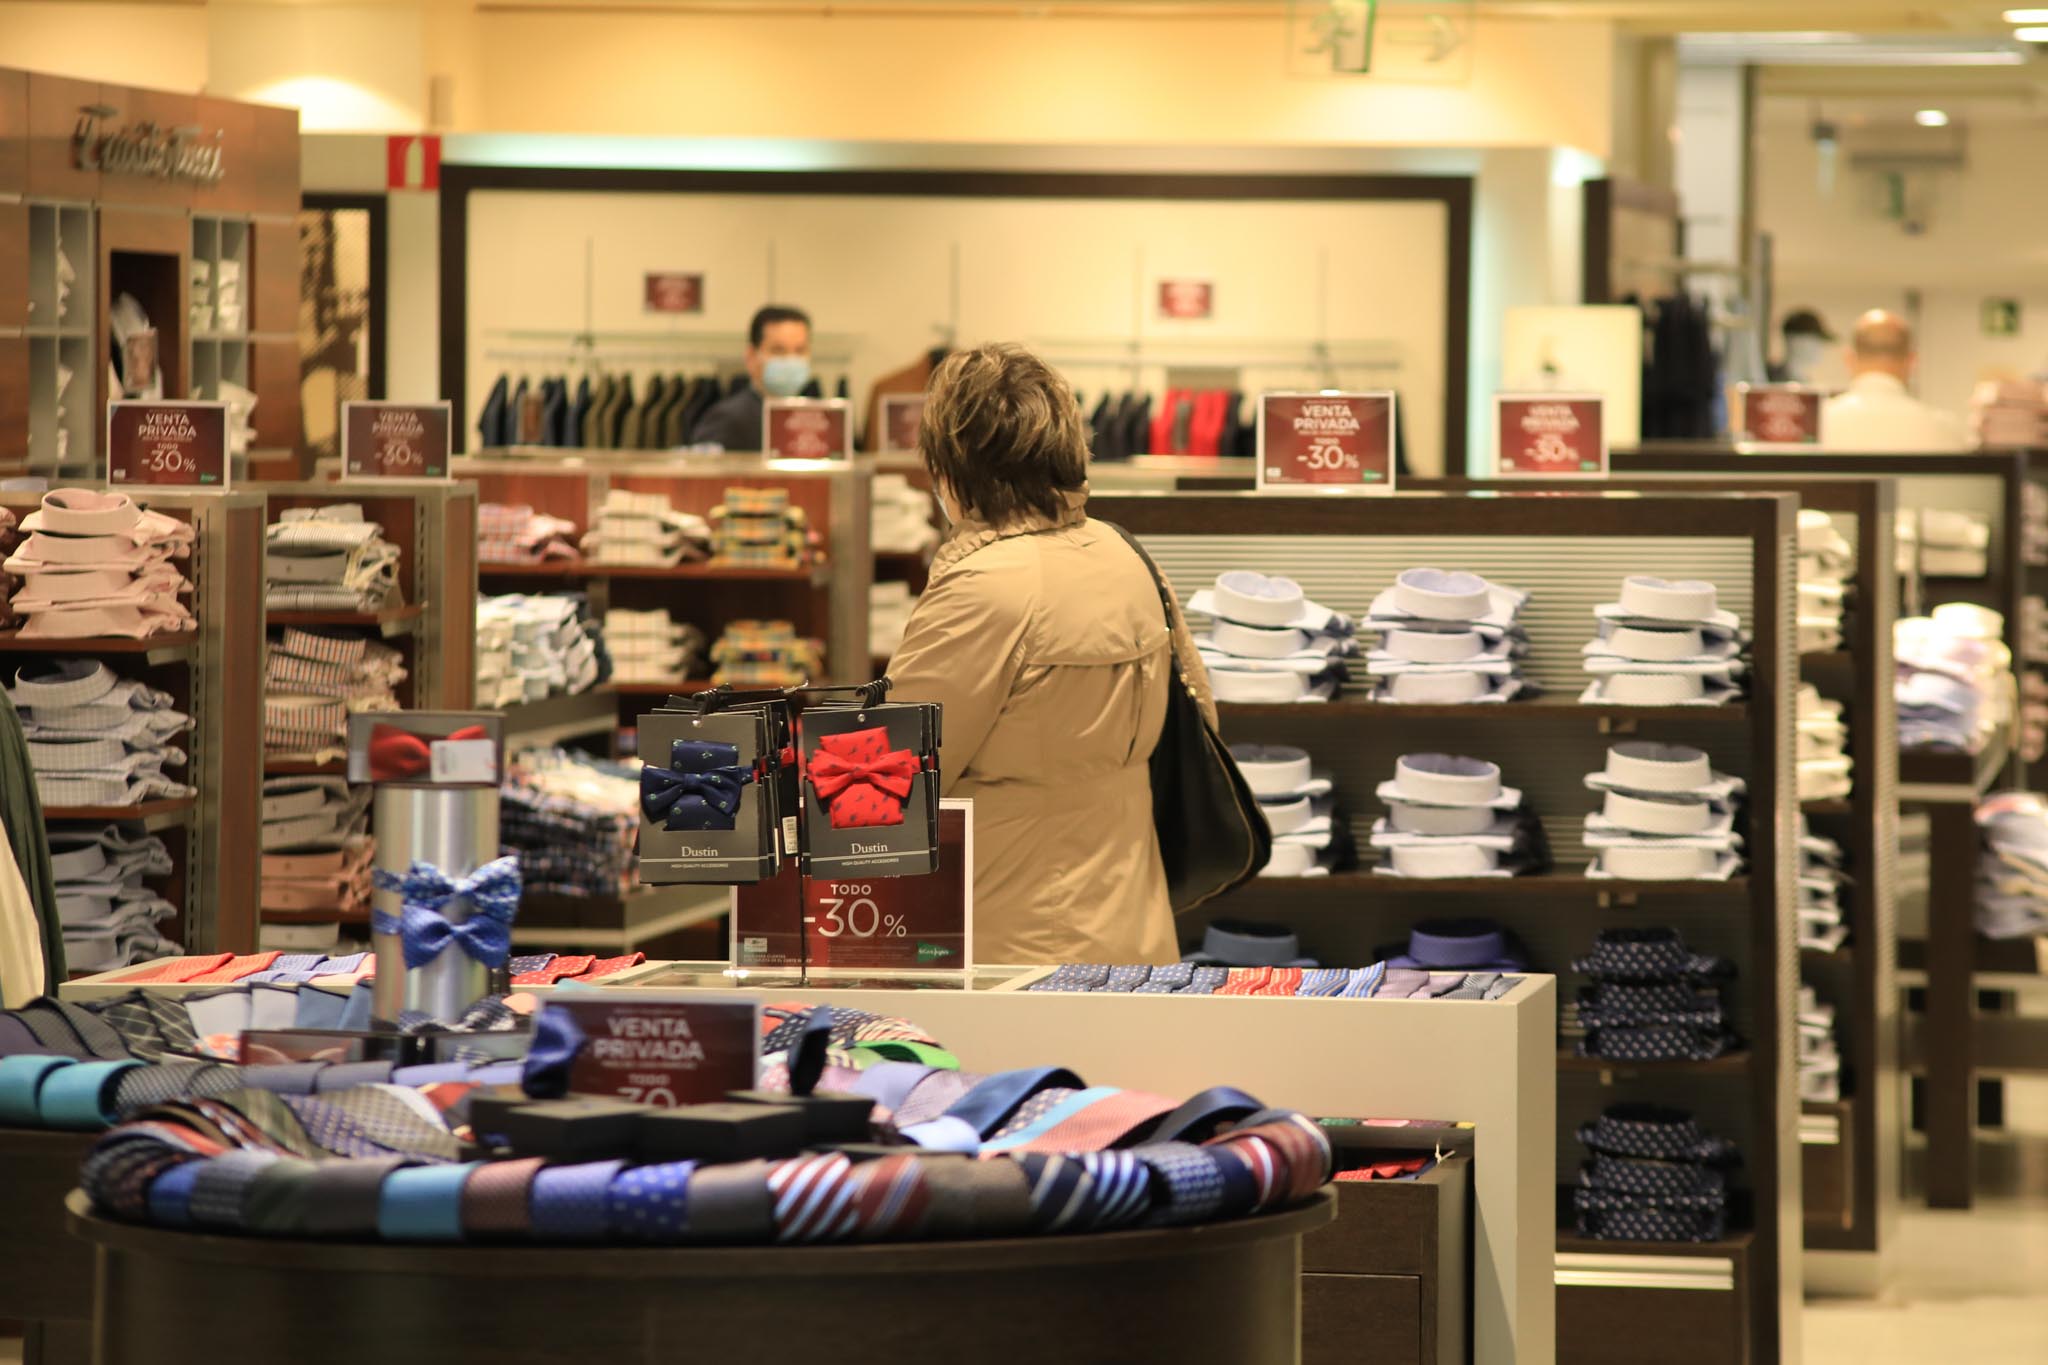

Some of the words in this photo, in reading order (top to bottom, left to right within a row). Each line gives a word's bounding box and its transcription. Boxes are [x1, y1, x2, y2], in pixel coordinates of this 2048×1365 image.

[1301, 405, 1352, 417] VENTA
[145, 413, 190, 425] VENTA
[1293, 417, 1360, 430] PRIVADA
[138, 424, 197, 437] PRIVADA
[141, 449, 196, 472] -30%
[1296, 445, 1360, 469] -30%
[681, 846, 718, 857] Dustin
[851, 842, 888, 855] Dustin
[830, 884, 872, 896] TODO
[803, 898, 907, 938] -30%
[606, 1017, 692, 1038] VENTA
[593, 1039, 704, 1060] PRIVADA
